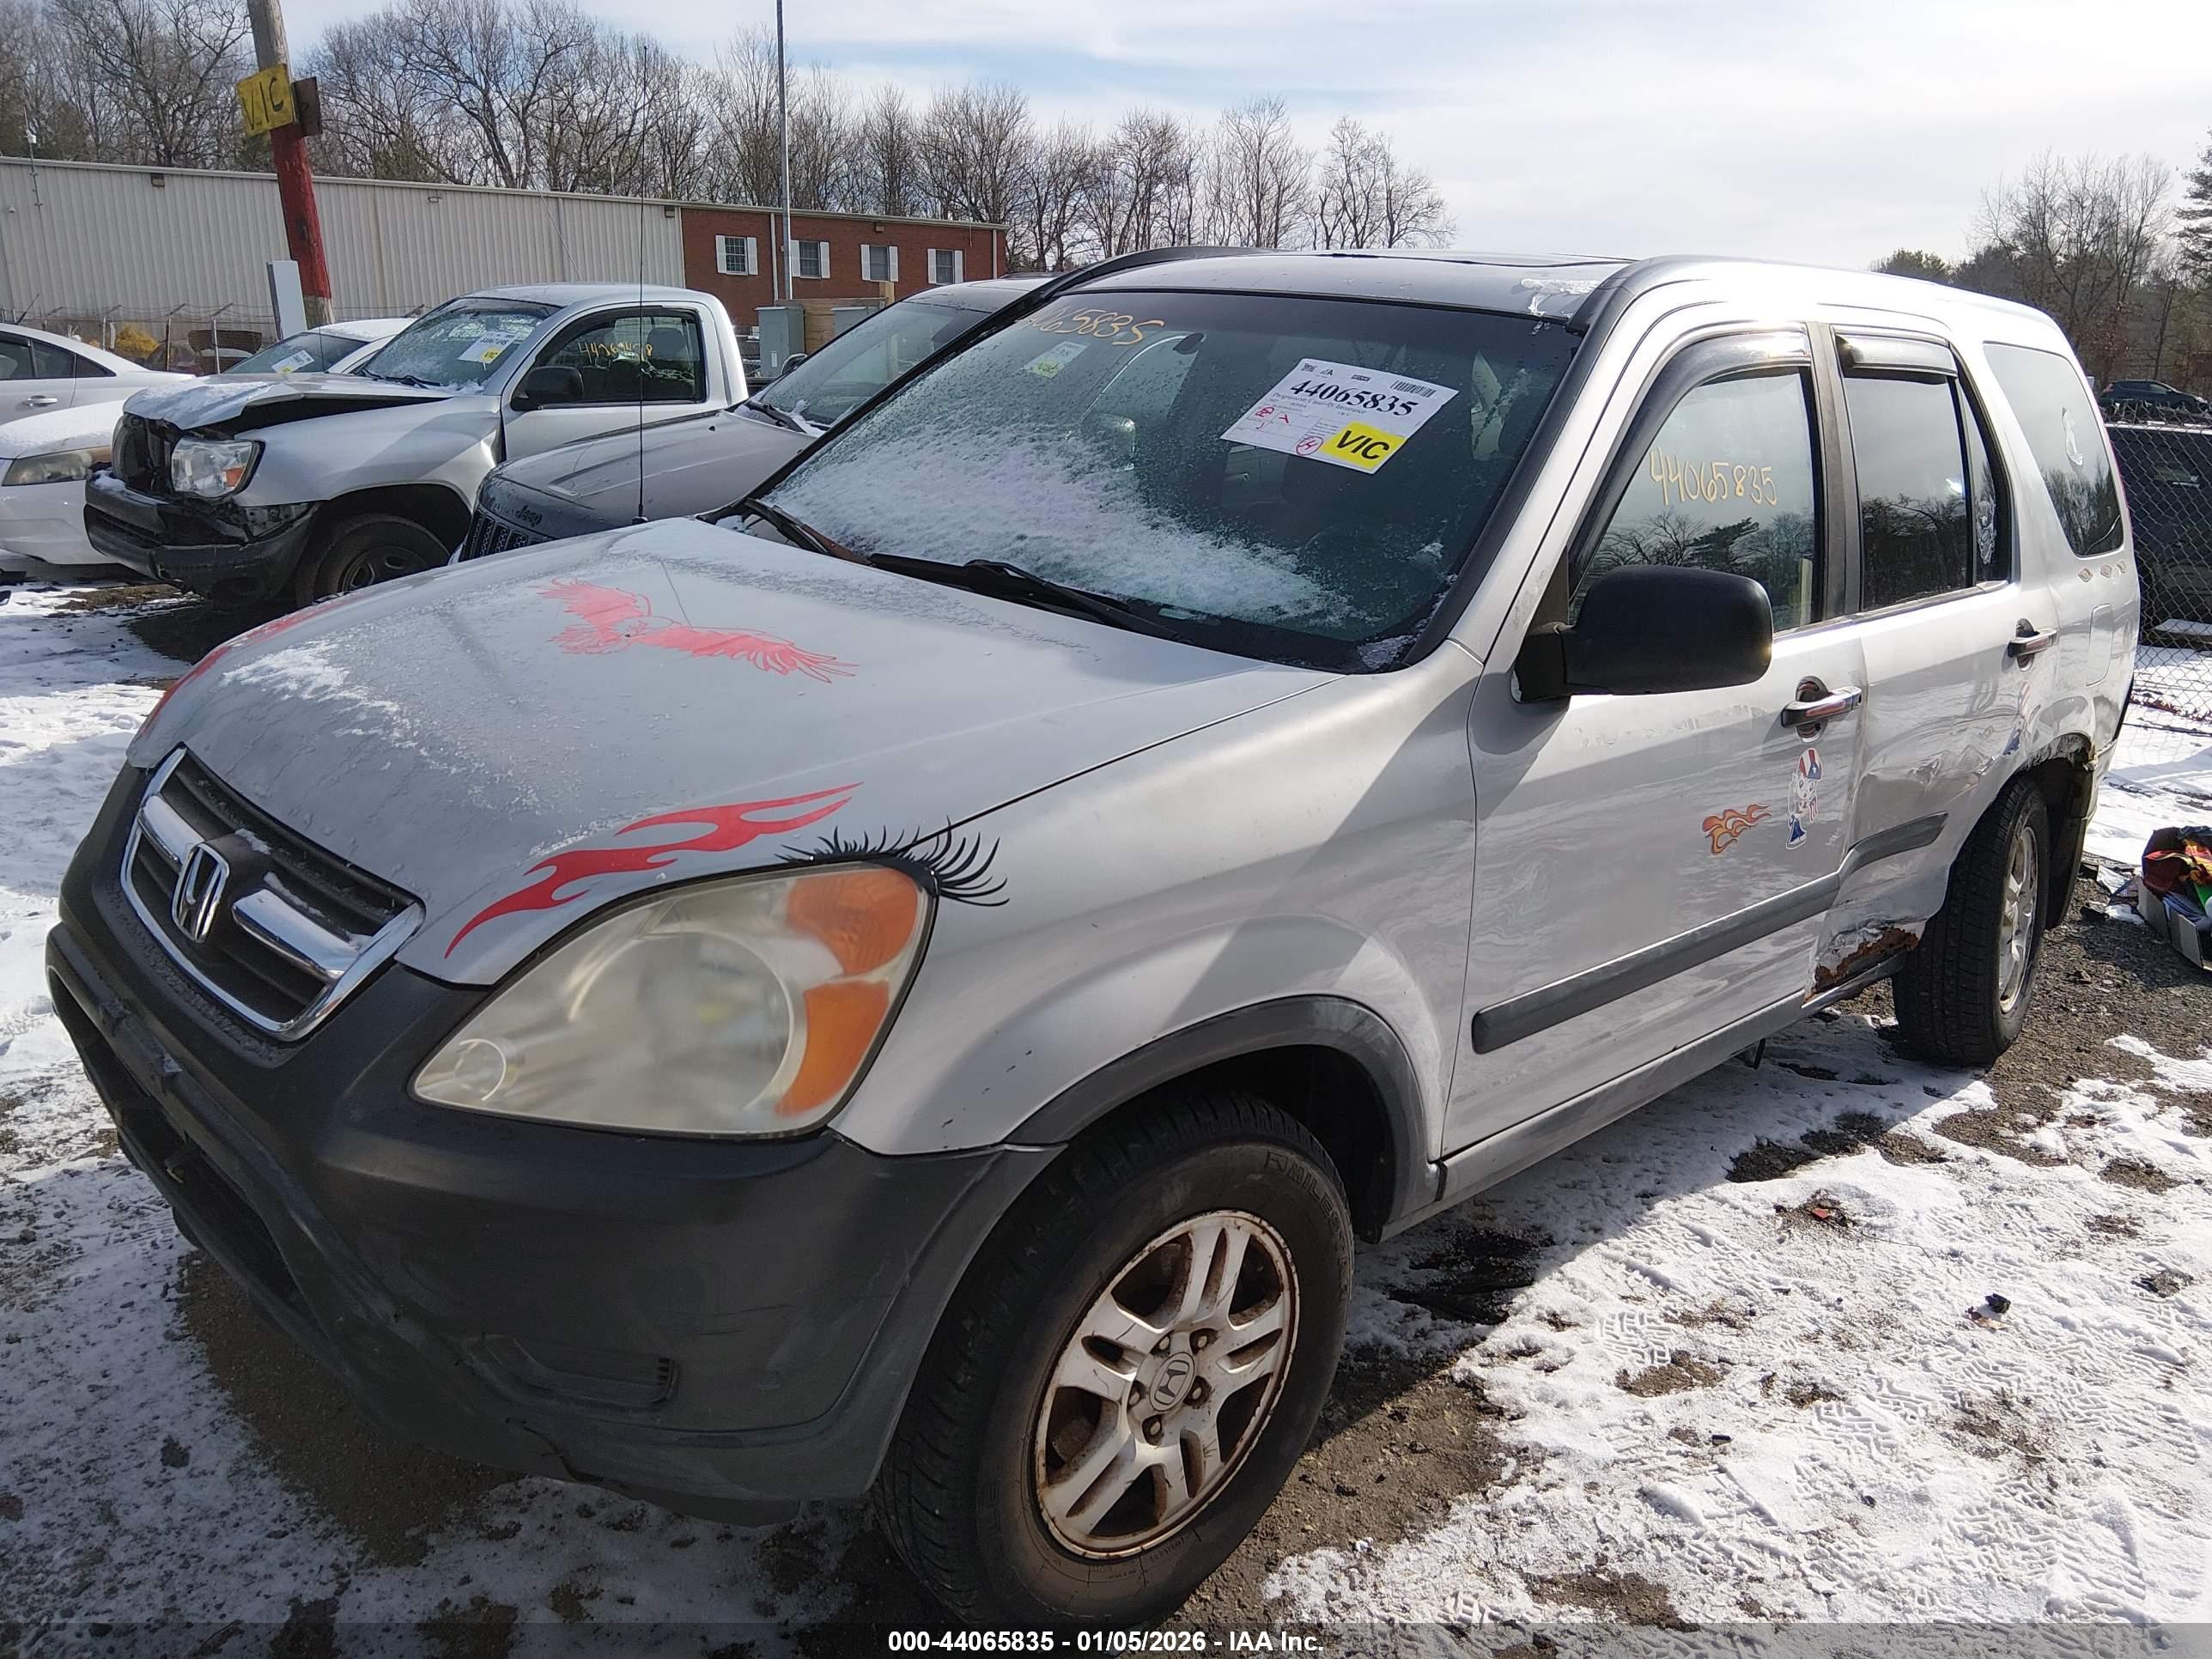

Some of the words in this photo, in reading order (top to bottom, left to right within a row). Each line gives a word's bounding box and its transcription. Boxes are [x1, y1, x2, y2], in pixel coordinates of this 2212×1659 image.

[240, 76, 284, 131] VIC
[1291, 380, 1419, 416] 44065835
[1335, 428, 1391, 461] VIC
[1650, 446, 1778, 507] 44065835
[515, 505, 543, 527] Jeep
[1286, 1159, 1349, 1291] MILES
